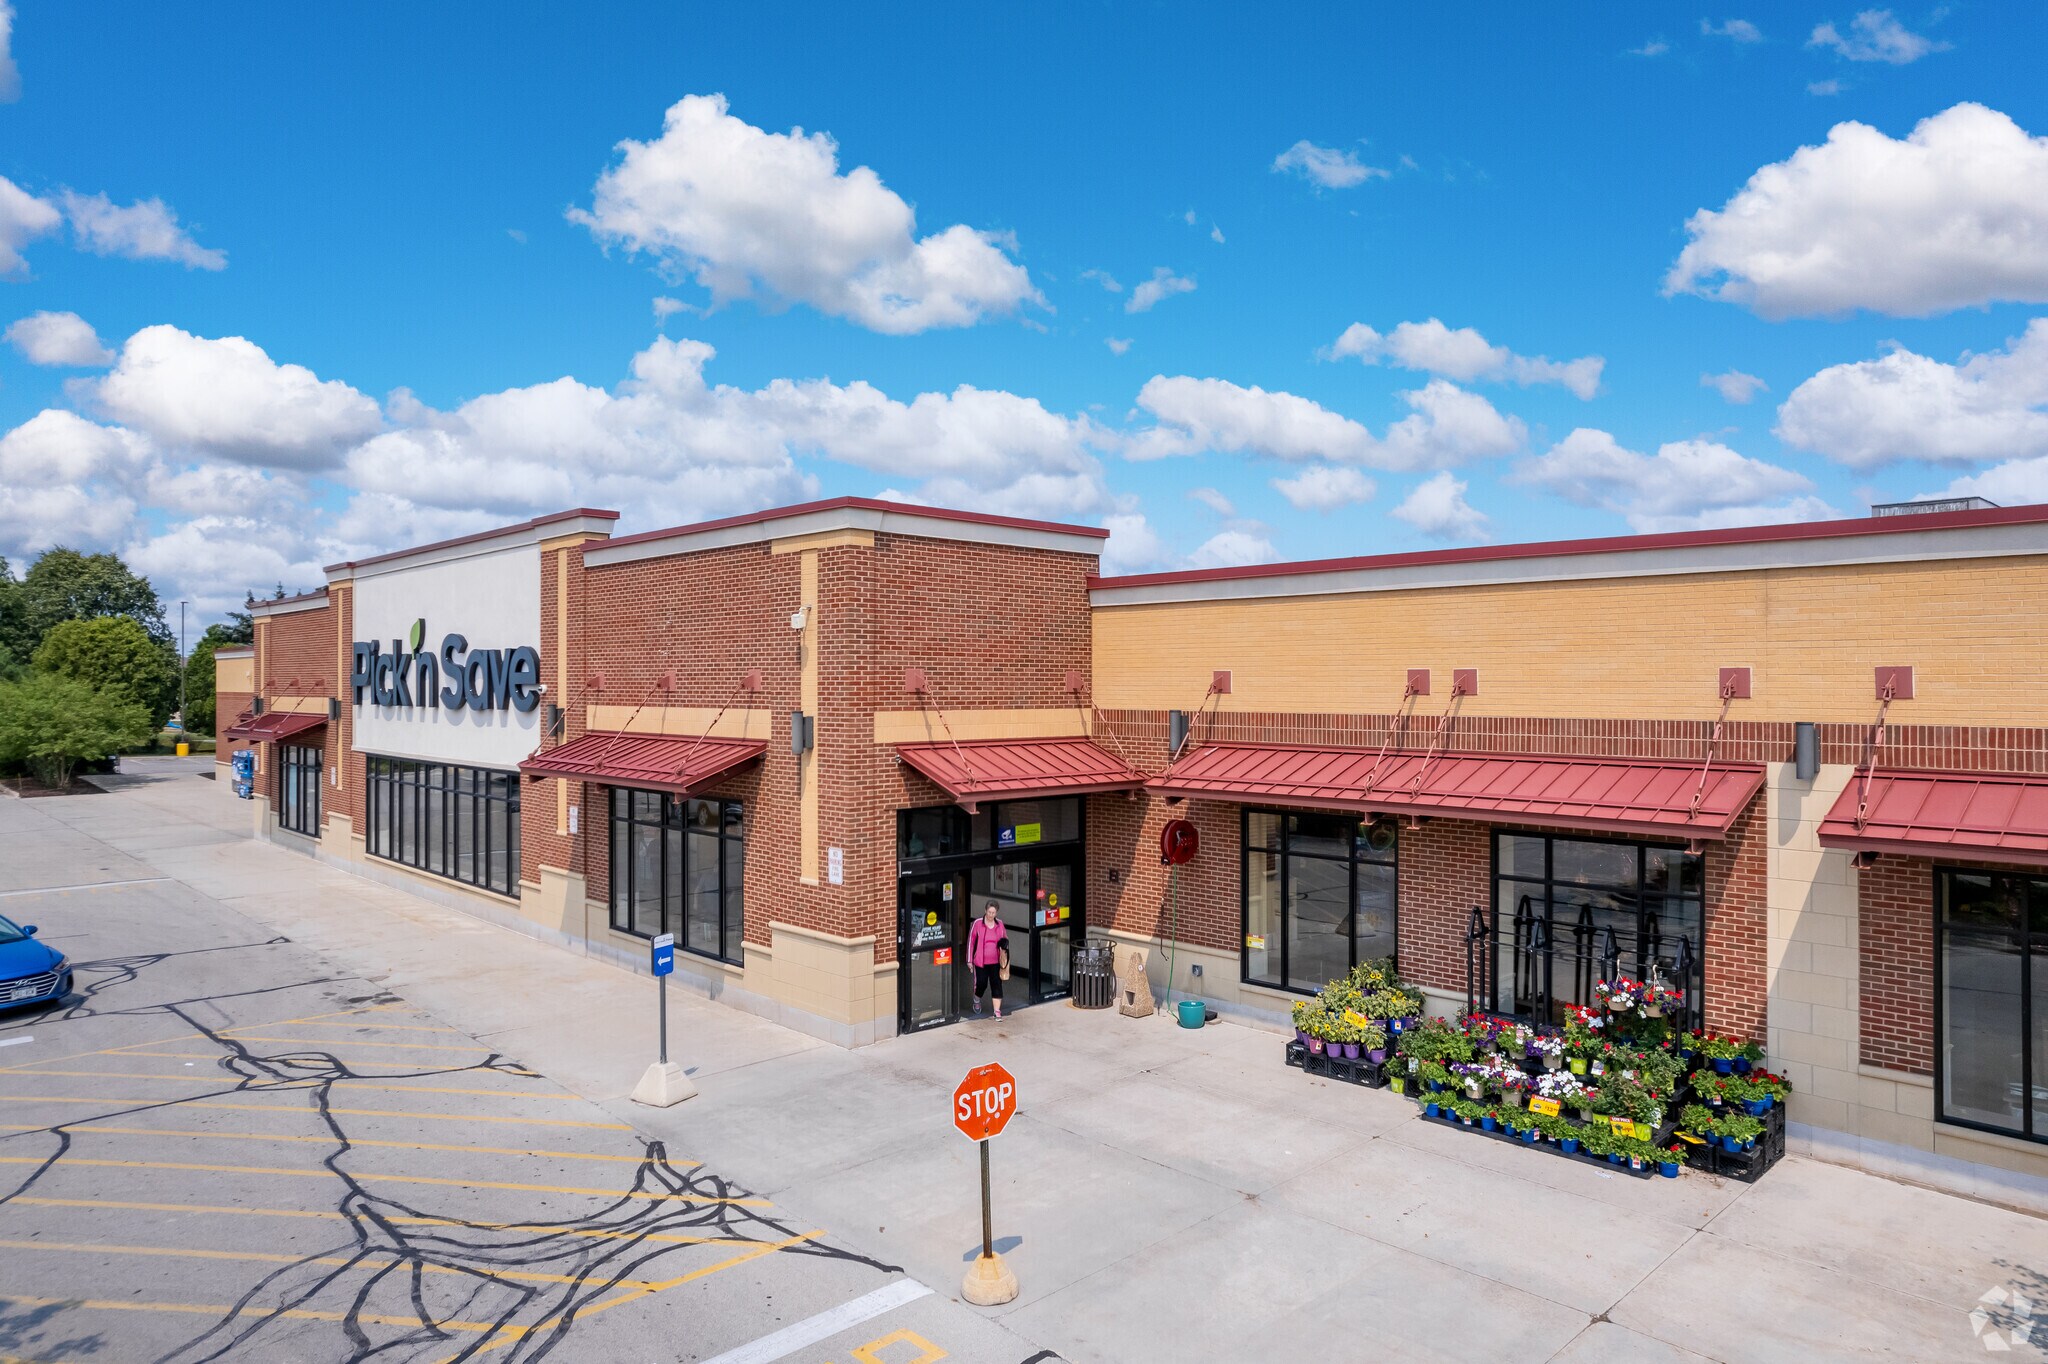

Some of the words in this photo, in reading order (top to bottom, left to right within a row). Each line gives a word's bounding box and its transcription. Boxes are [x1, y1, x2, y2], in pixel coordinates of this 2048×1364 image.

[440, 633, 541, 712] Save
[957, 1082, 1013, 1122] STOP
[1534, 1094, 1545, 1102] LOW
